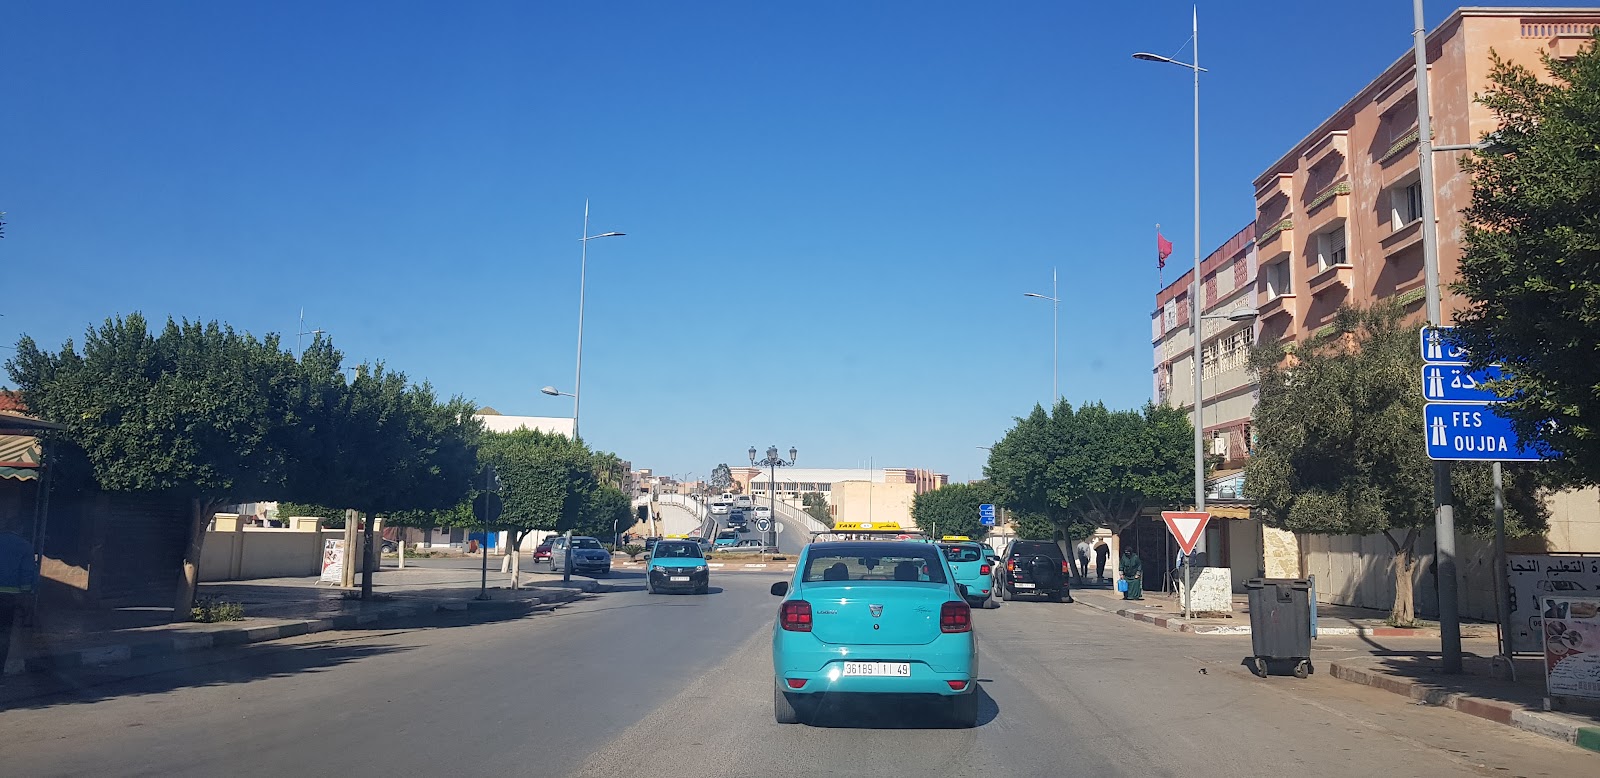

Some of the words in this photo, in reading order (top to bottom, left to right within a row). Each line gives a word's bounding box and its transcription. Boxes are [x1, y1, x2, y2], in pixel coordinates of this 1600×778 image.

[1453, 412, 1482, 428] FES
[1454, 436, 1508, 452] OUJDA
[1507, 559, 1540, 577] النجا
[1546, 559, 1586, 579] التعليم
[897, 664, 908, 675] 49
